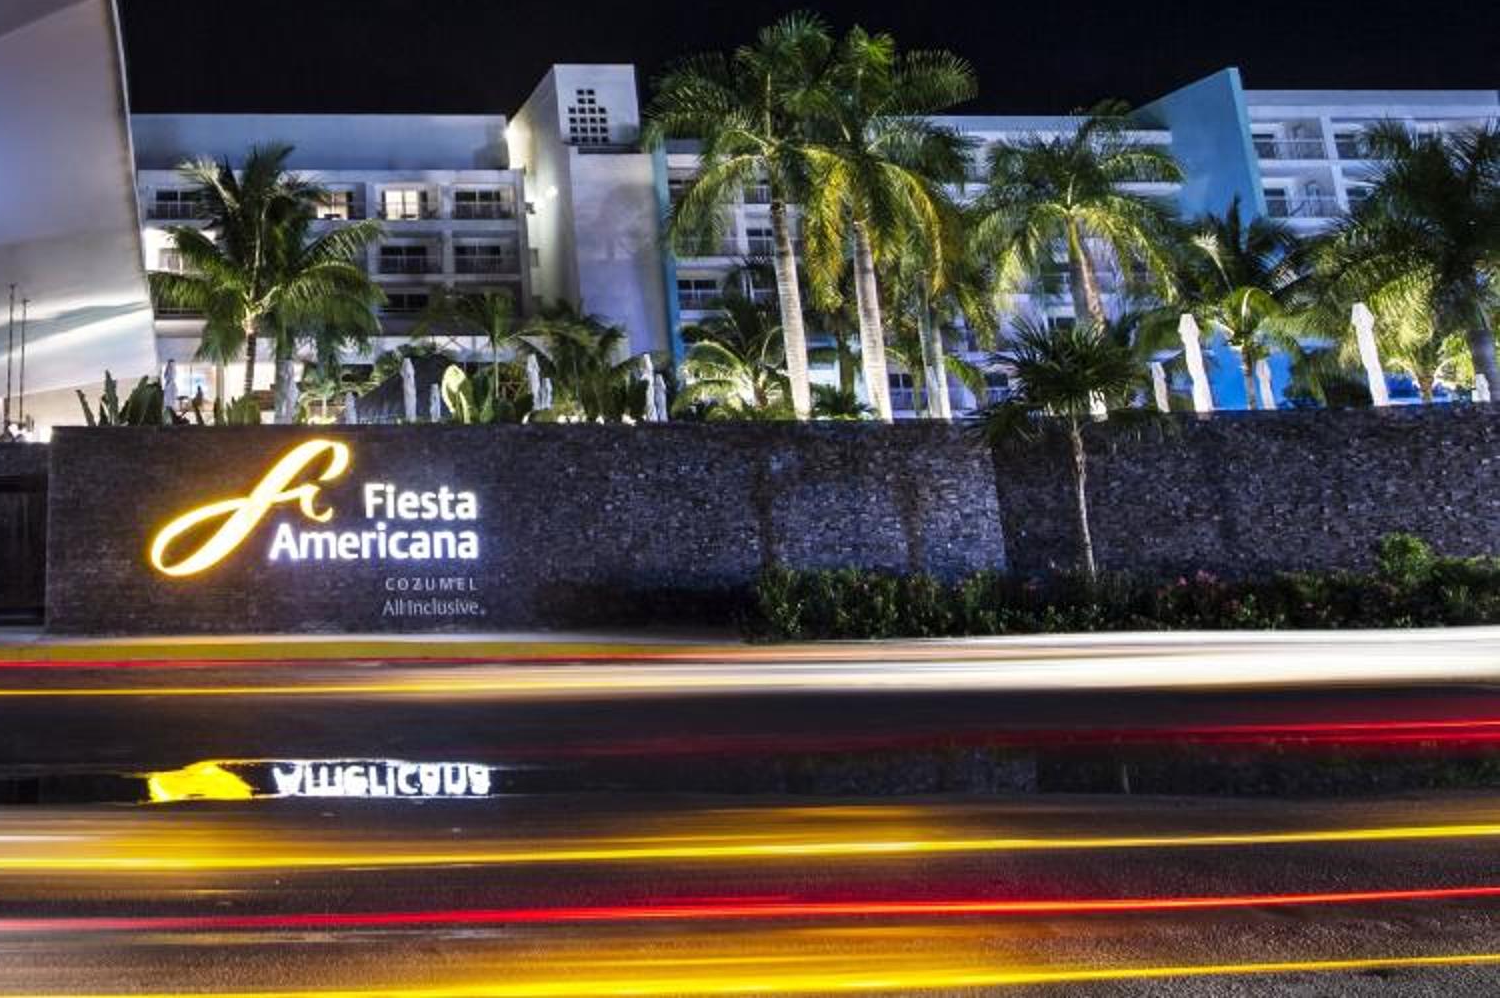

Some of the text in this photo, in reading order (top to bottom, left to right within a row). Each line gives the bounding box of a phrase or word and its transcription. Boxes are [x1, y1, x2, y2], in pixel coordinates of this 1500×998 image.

[364, 483, 478, 521] Fiesta
[268, 522, 479, 561] Americana
[385, 577, 478, 592] COZUMEL
[381, 599, 404, 616] All
